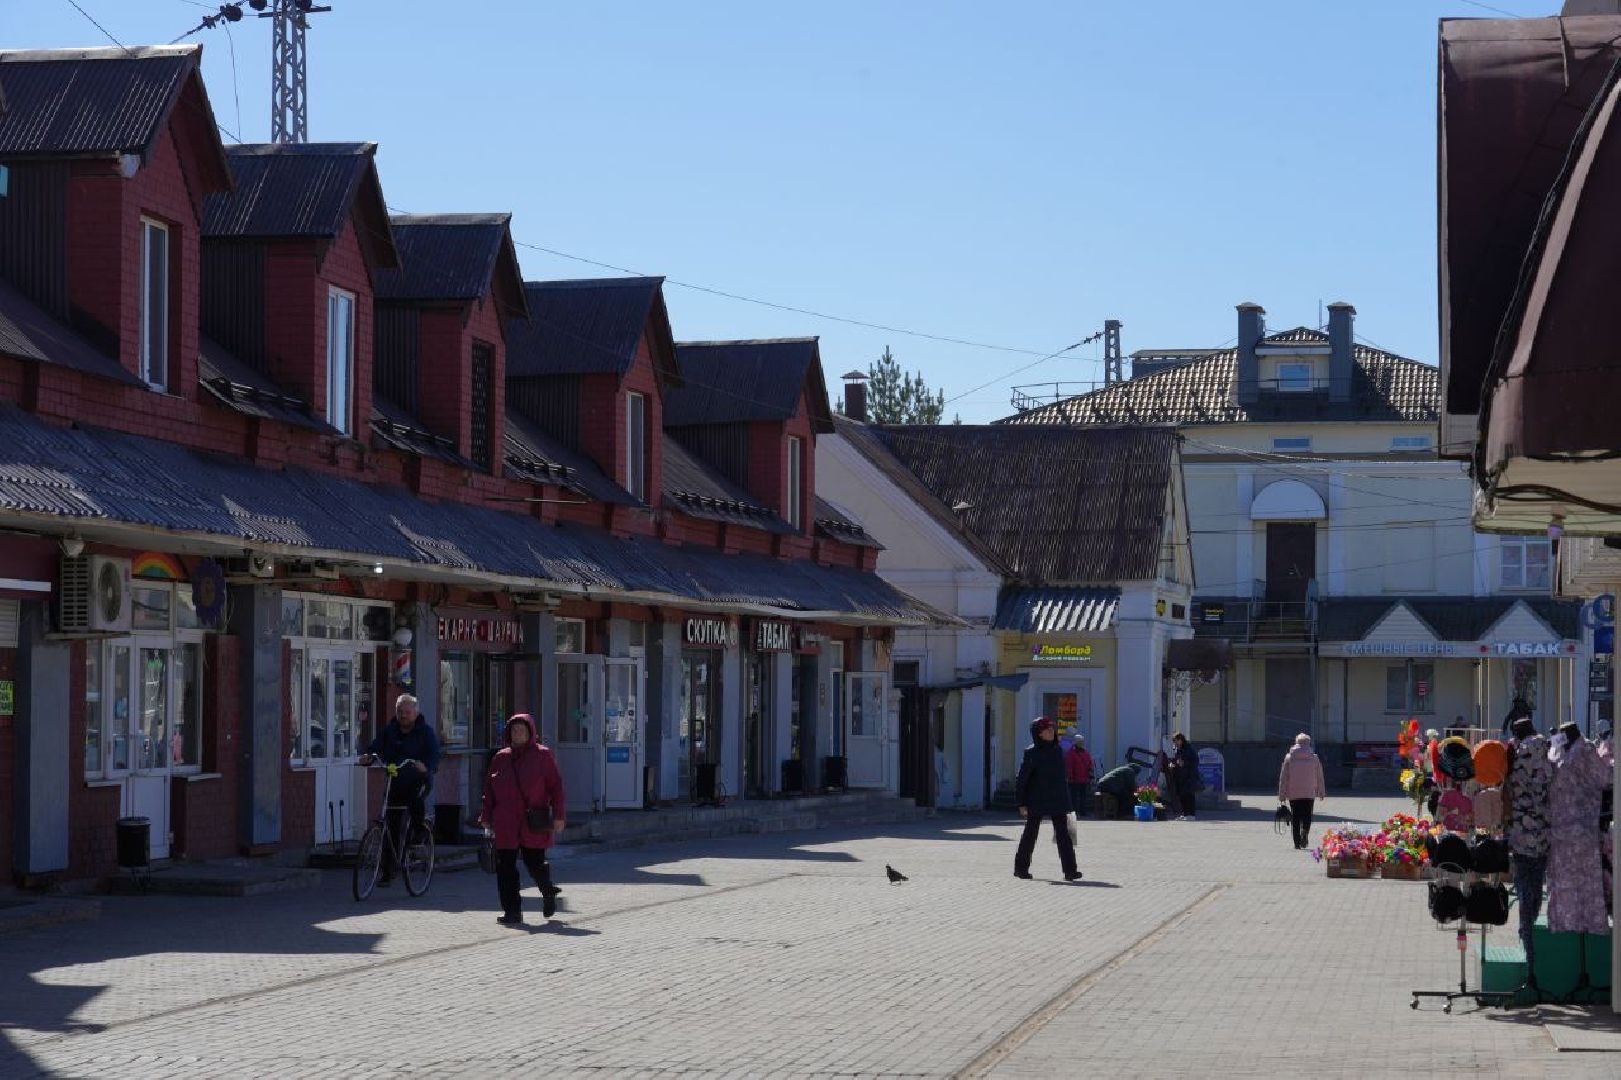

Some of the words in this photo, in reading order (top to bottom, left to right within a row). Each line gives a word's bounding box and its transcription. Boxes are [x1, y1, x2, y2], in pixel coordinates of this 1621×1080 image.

[438, 617, 478, 641] ЕКАРНЯ
[687, 618, 727, 644] СКУПКА
[762, 622, 792, 650] ТАБАК
[1040, 644, 1092, 656] Ломбард
[1494, 642, 1561, 655] ТАБАК
